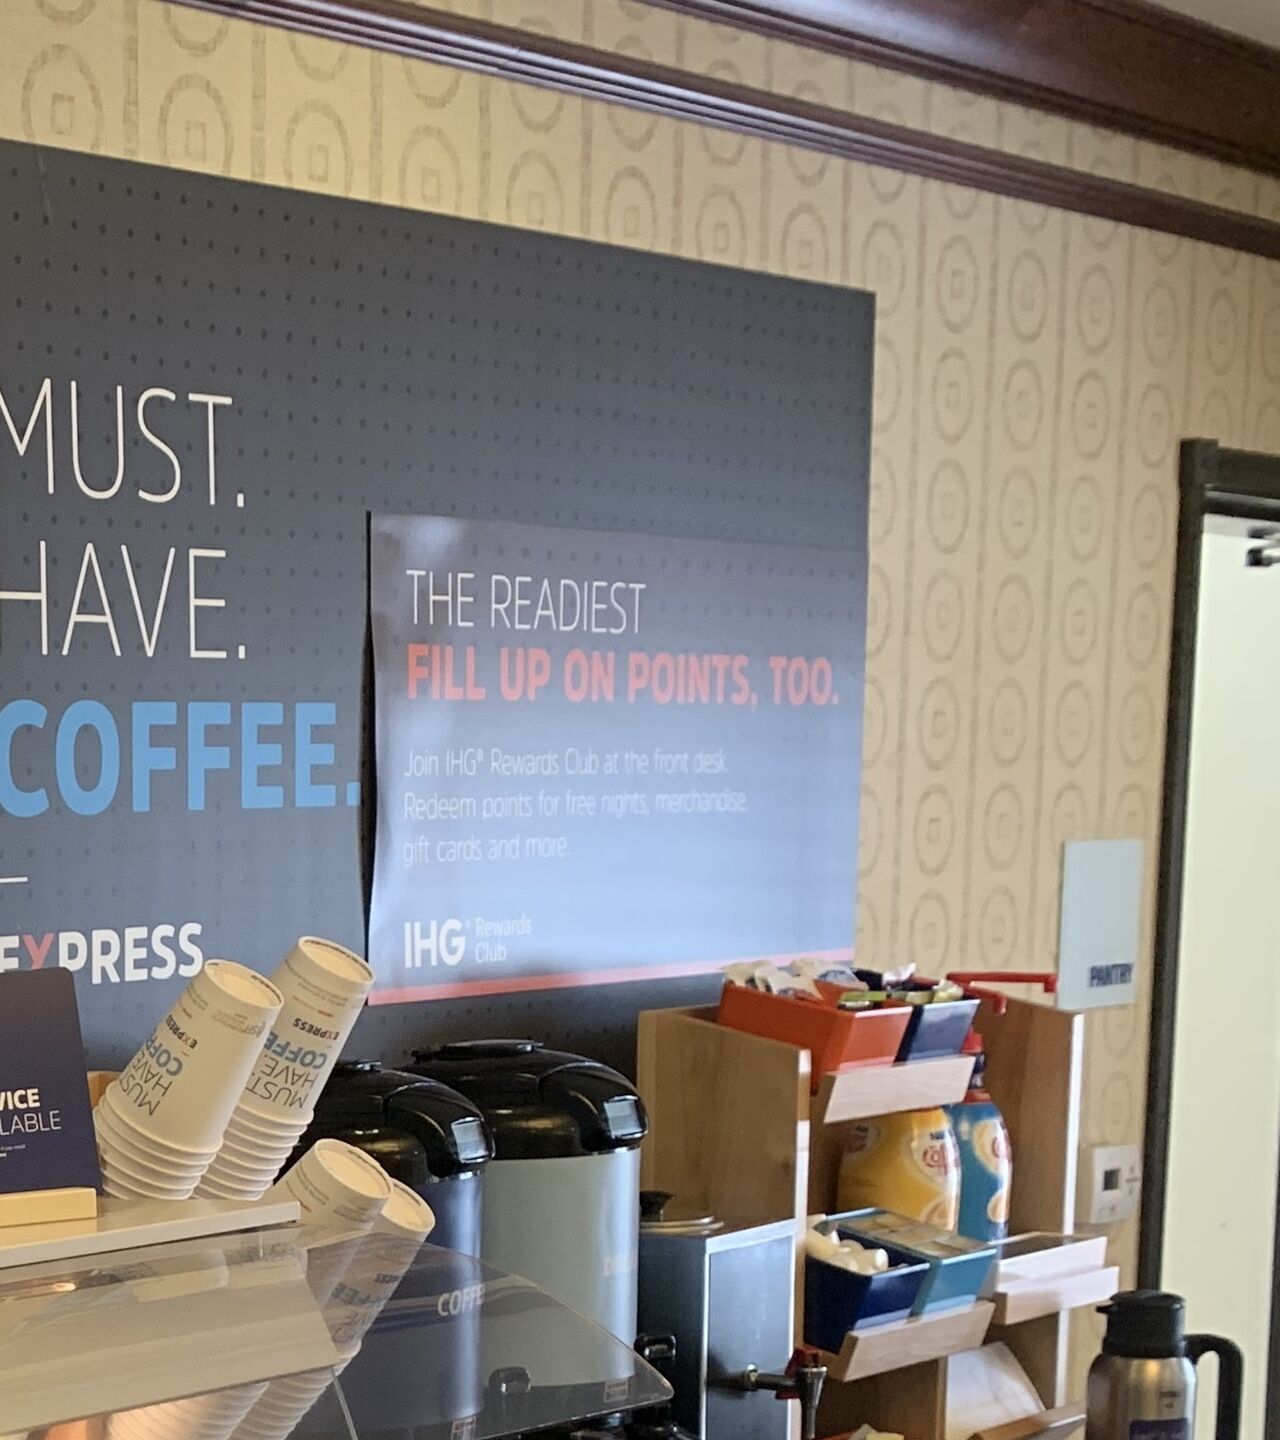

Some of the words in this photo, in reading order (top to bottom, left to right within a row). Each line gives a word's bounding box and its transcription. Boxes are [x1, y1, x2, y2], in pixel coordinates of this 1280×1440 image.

[406, 569, 475, 627] THE
[490, 574, 646, 634] READIEST
[407, 643, 486, 701] FILL
[500, 646, 551, 702] UP
[563, 648, 615, 702] ON
[628, 651, 758, 711] POINTS,
[769, 655, 839, 706] TOO.
[403, 749, 439, 777] Join
[490, 748, 560, 775] Rewards
[565, 747, 600, 775] Club
[603, 753, 619, 774] at
[624, 750, 650, 774] the
[654, 747, 689, 774] front
[403, 791, 477, 820] Redeem
[482, 793, 533, 820] points
[539, 790, 561, 816] for
[566, 789, 597, 815] free
[403, 835, 430, 868] gift
[437, 835, 483, 862] cards
[488, 834, 521, 860] and
[474, 912, 534, 938] Rewards
[475, 941, 508, 964] Club
[292, 1018, 340, 1041] EXPRESS
